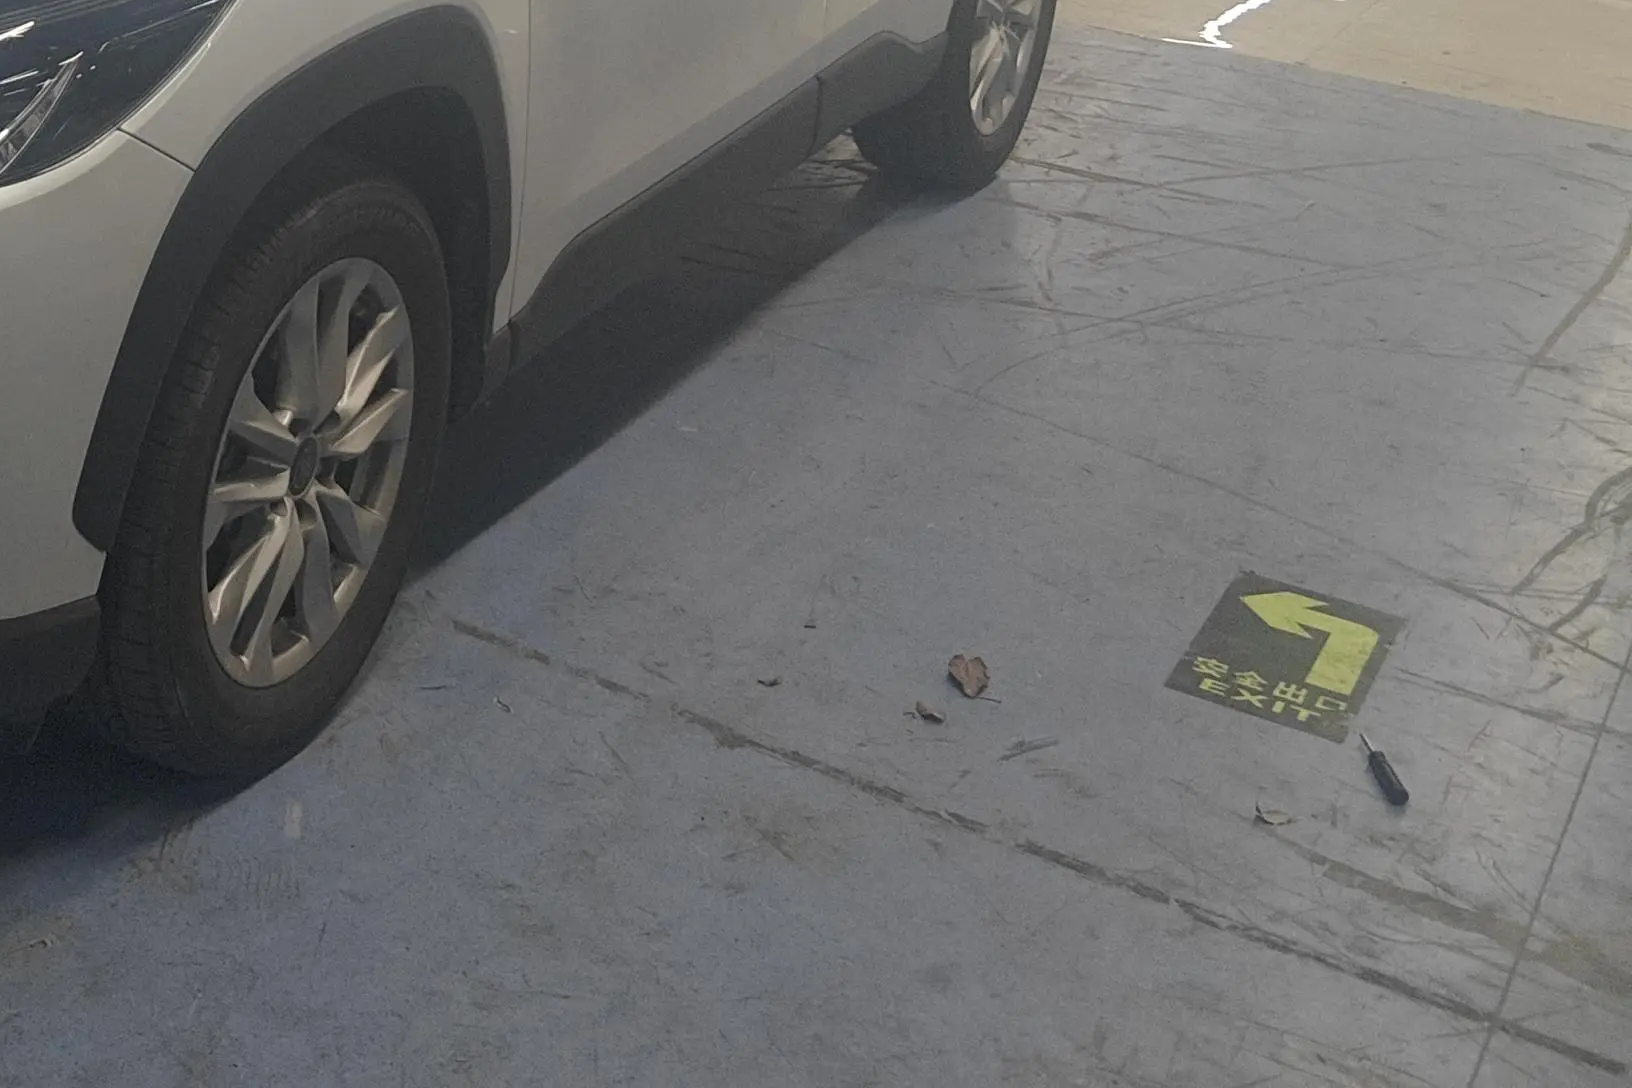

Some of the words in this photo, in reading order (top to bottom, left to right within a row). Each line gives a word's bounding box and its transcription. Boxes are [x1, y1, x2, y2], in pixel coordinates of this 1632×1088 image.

[1192, 656, 1348, 711] 安全出口
[1199, 678, 1322, 722] EXIT
